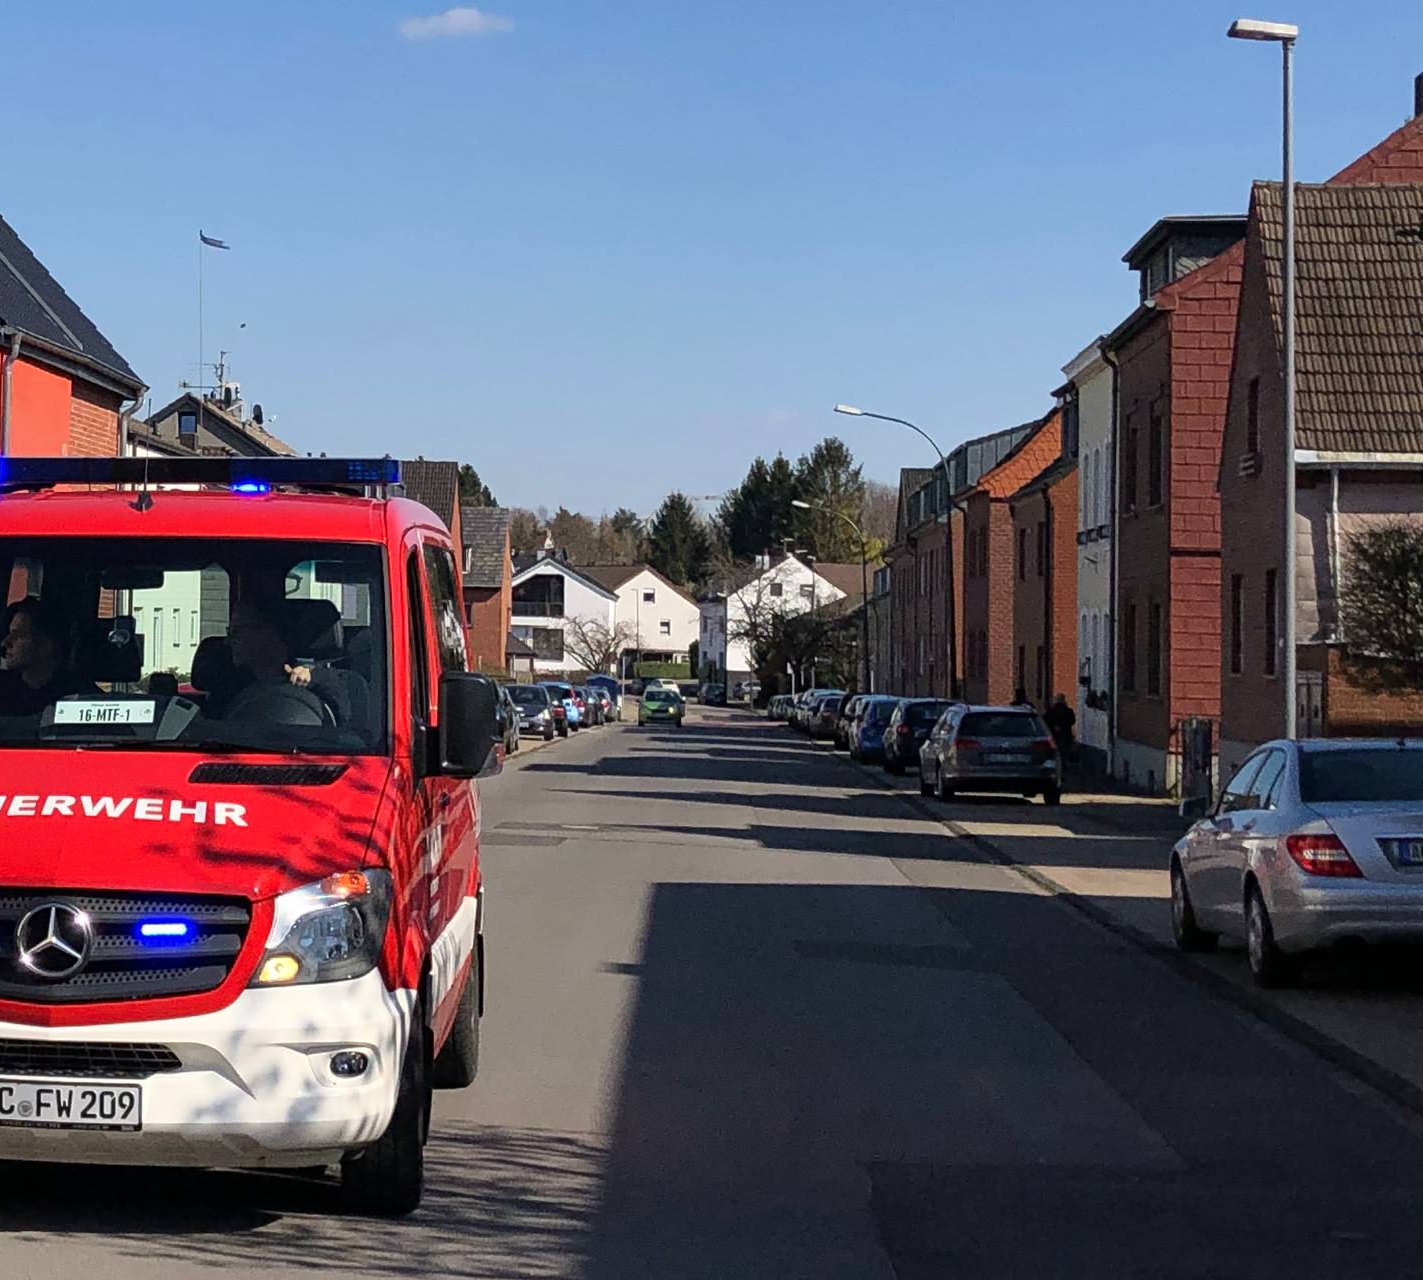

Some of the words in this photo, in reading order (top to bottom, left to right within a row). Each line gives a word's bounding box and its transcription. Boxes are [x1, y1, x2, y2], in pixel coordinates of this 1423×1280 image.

[79, 708, 131, 722] 16-MTF-1
[36, 1089, 74, 1118] FW
[80, 1091, 135, 1120] 209
